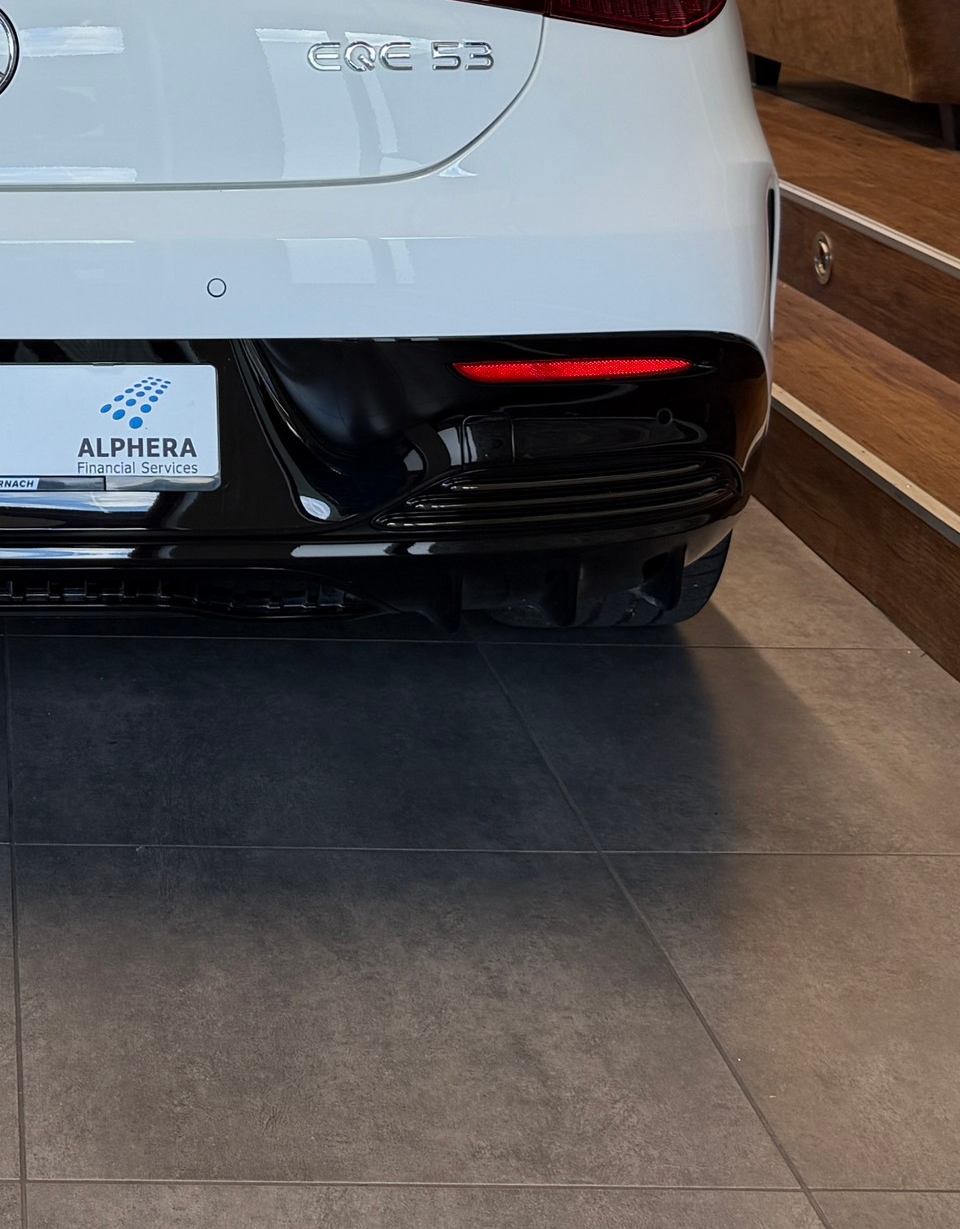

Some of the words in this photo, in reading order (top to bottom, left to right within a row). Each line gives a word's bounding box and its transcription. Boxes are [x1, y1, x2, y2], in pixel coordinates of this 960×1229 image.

[307, 40, 413, 71] EQE
[431, 40, 494, 71] 53
[77, 437, 198, 458] ALPHERA
[77, 461, 136, 474] Financial
[141, 461, 198, 474] Services
